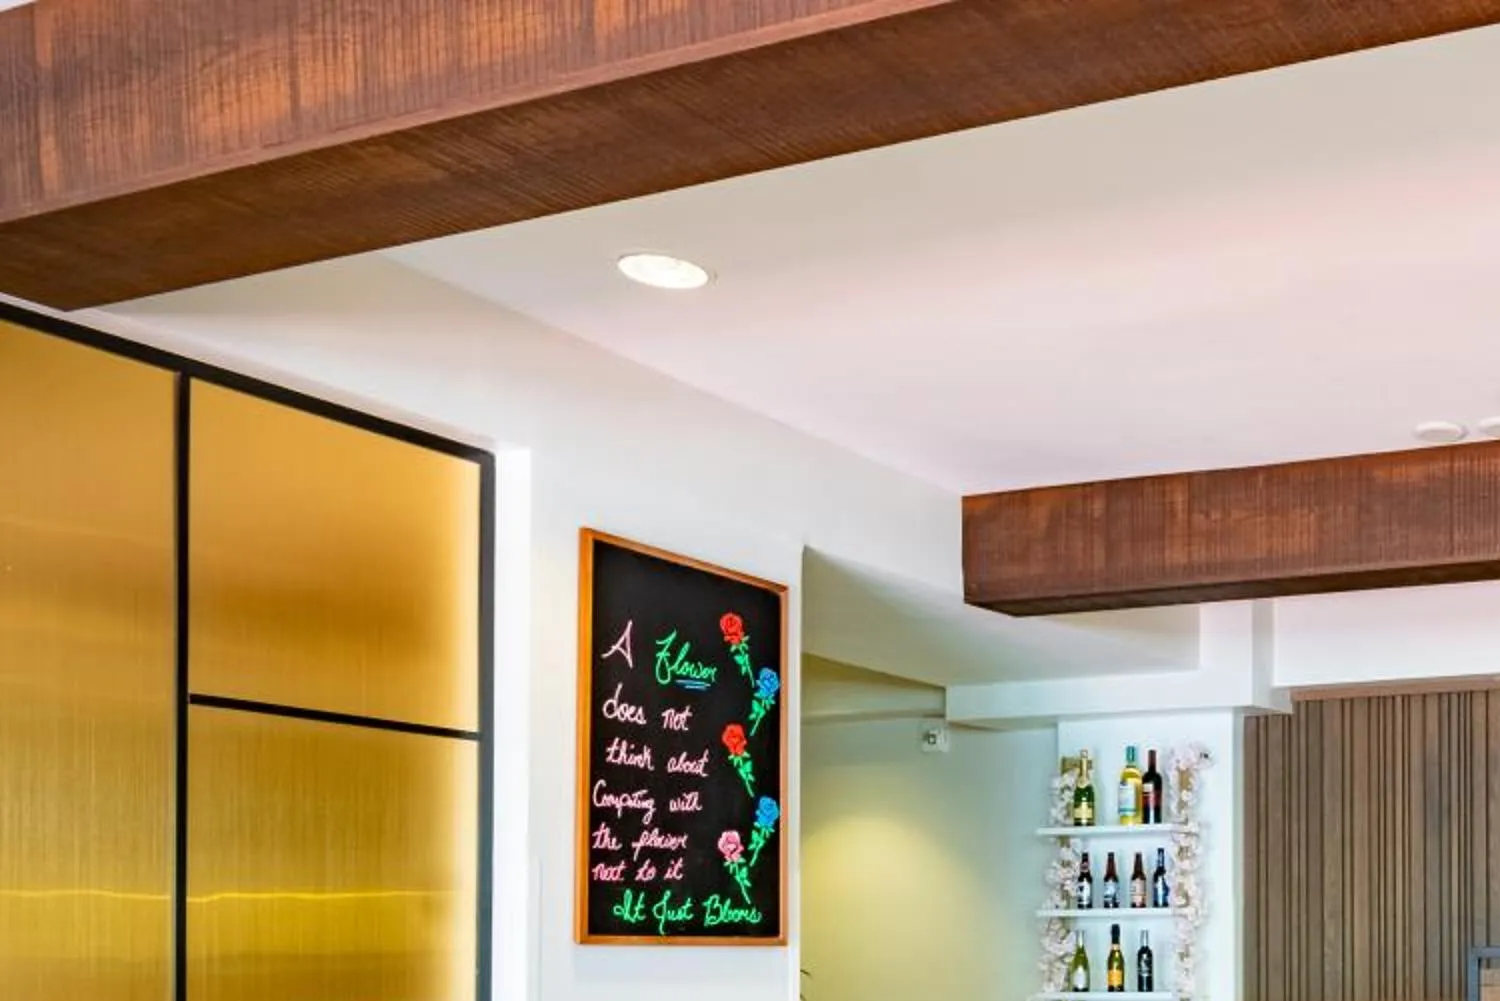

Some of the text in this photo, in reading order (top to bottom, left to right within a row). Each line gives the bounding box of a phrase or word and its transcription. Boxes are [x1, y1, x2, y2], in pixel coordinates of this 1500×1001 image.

[602, 619, 718, 685] A Flower
[602, 682, 693, 732] does not
[606, 737, 709, 777] think about
[669, 791, 703, 813] with
[592, 822, 689, 862] the flower
[635, 858, 657, 882] to
[664, 857, 684, 881] it
[613, 889, 763, 936] It Just Blooms
